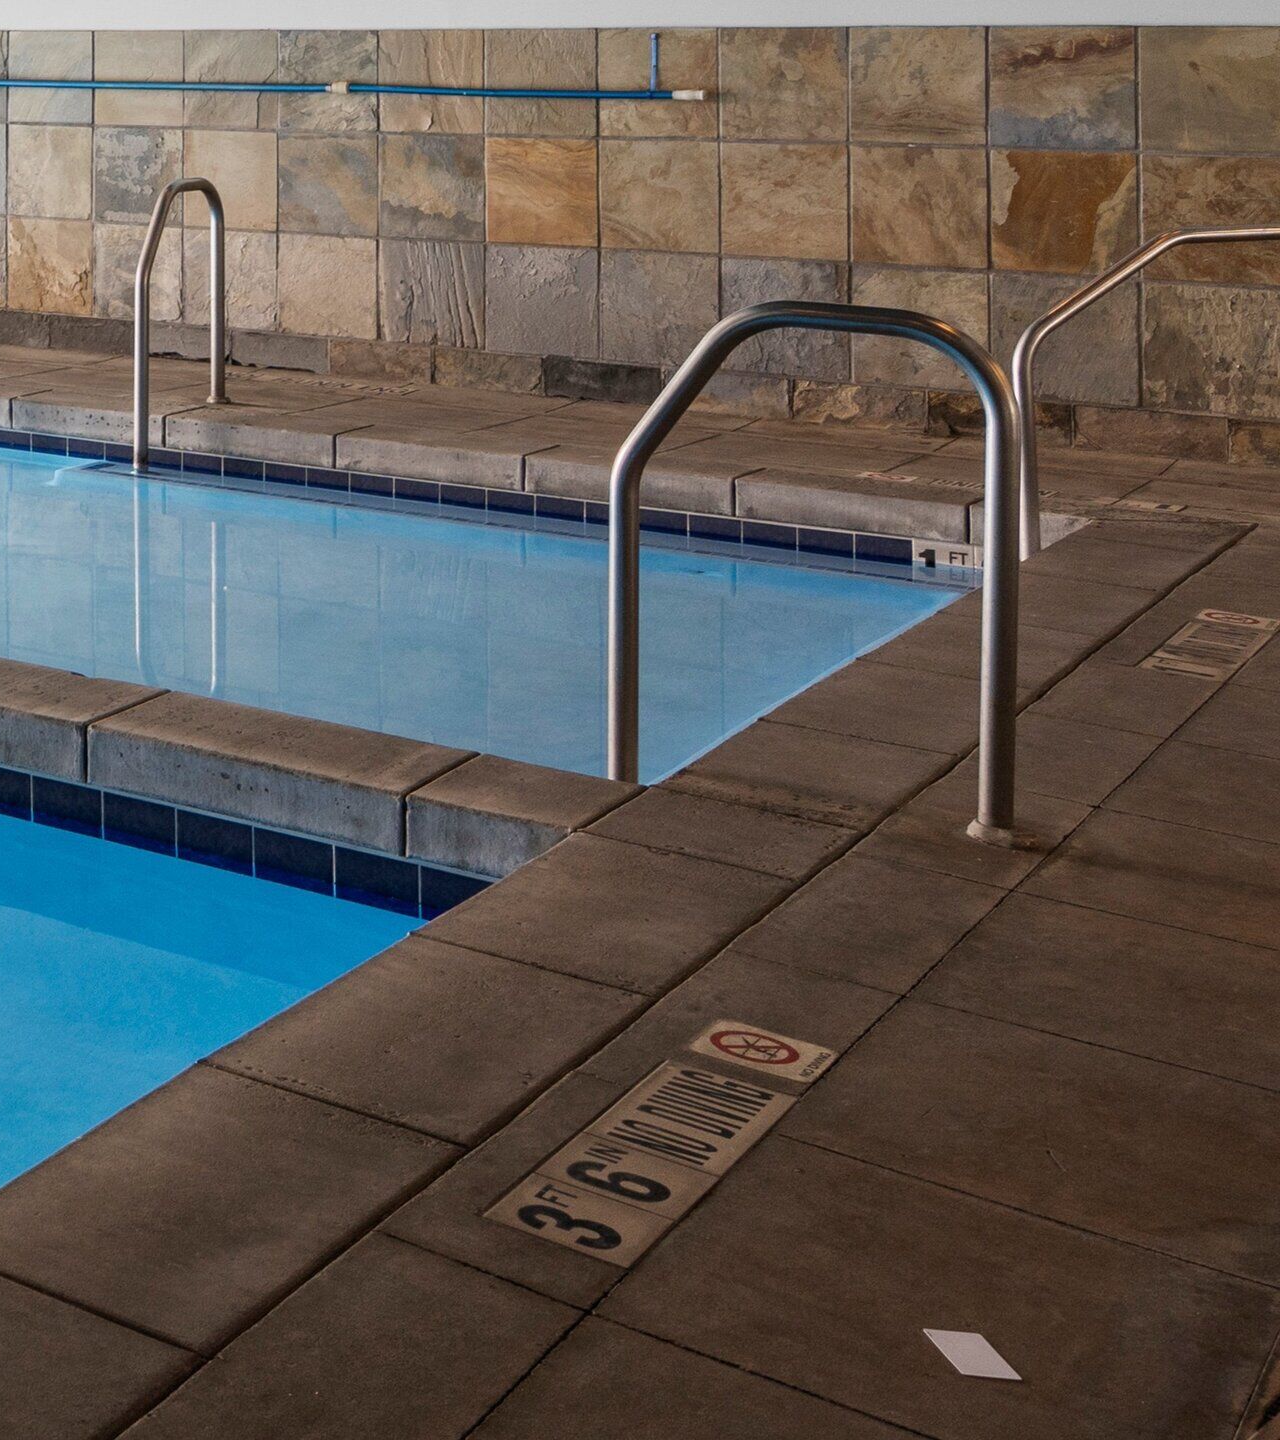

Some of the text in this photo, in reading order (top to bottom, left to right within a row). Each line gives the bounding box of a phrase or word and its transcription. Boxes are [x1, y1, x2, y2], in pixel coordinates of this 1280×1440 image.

[918, 549, 968, 568] 1 FT
[518, 1069, 774, 1250] 3 FT 6 IN NO DIVING
